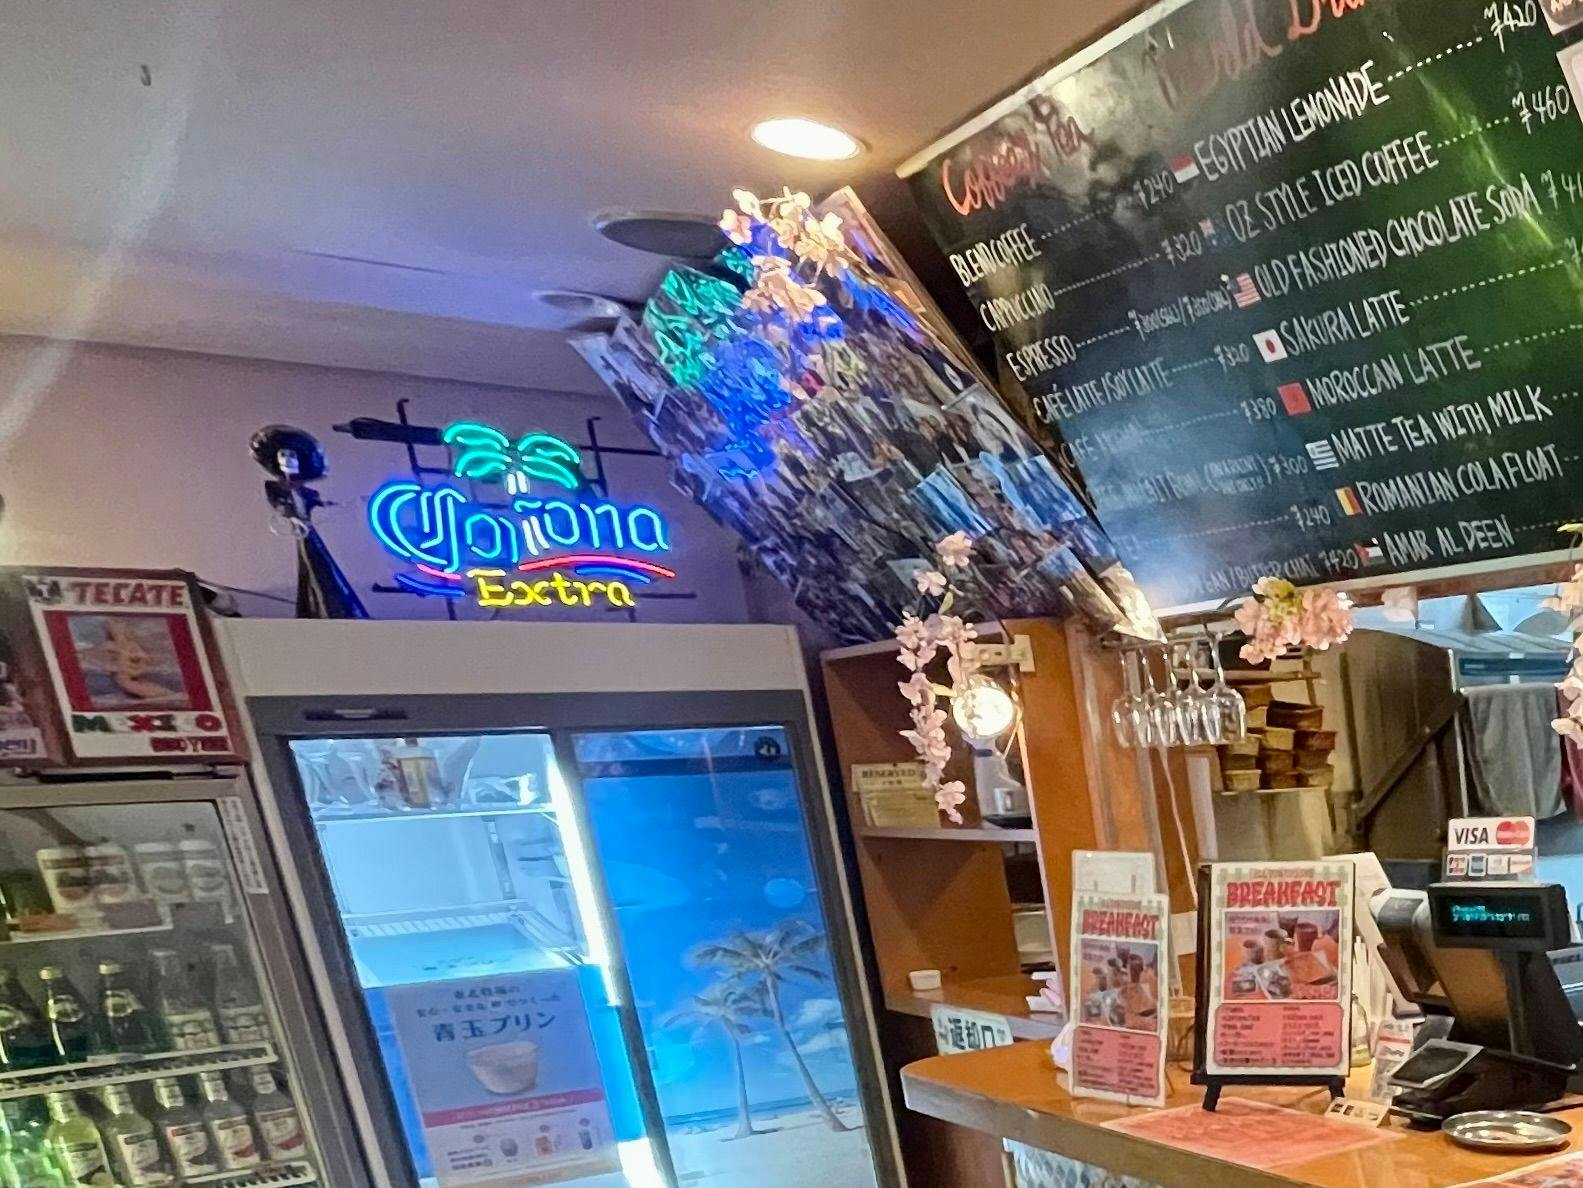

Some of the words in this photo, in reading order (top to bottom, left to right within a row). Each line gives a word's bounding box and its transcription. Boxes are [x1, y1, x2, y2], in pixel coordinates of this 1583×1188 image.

[1194, 108, 1289, 181] EGYPTIAN
[1281, 60, 1390, 141] LEMONADE
[1225, 201, 1260, 242] OZ
[1255, 177, 1318, 230] STYLE
[1312, 160, 1362, 207] ICED
[1362, 131, 1439, 186] COFFEE
[949, 238, 998, 287] BLEND
[990, 223, 1041, 275] COFFEE
[1254, 260, 1289, 298] OLD
[1291, 228, 1387, 291] FASHIONED
[1387, 192, 1490, 257] CHOCOLATE
[1486, 173, 1542, 224] SODA
[979, 283, 1056, 332] CAPPUCCINO
[1280, 307, 1351, 356] SAKURA
[1349, 290, 1410, 338] LATTE
[1006, 335, 1077, 383] ESPRESSO
[1128, 356, 1173, 398] LATTE
[1306, 354, 1404, 410] MOROCCAN
[1403, 335, 1481, 386] LATTE
[1331, 422, 1398, 464] MATTE
[1391, 414, 1437, 453] TEA
[1433, 402, 1491, 442] WITH
[1487, 385, 1553, 429] MILK
[1356, 467, 1459, 516] ROMANIAN
[1456, 456, 1510, 496] COLA
[1502, 444, 1563, 488] FLOAT
[370, 483, 671, 574] Corona
[1382, 528, 1434, 567] AMAR
[1436, 524, 1459, 560] AL
[1458, 514, 1516, 552] DEEN
[70, 581, 186, 606] TECATE
[467, 570, 637, 608] Extra
[72, 714, 222, 733] MXIO
[1454, 827, 1489, 845] VISA
[1226, 880, 1341, 908] BREAKFAST
[1082, 908, 1160, 939] BREAKFAST
[433, 1012, 556, 1042] 青玉プリン
